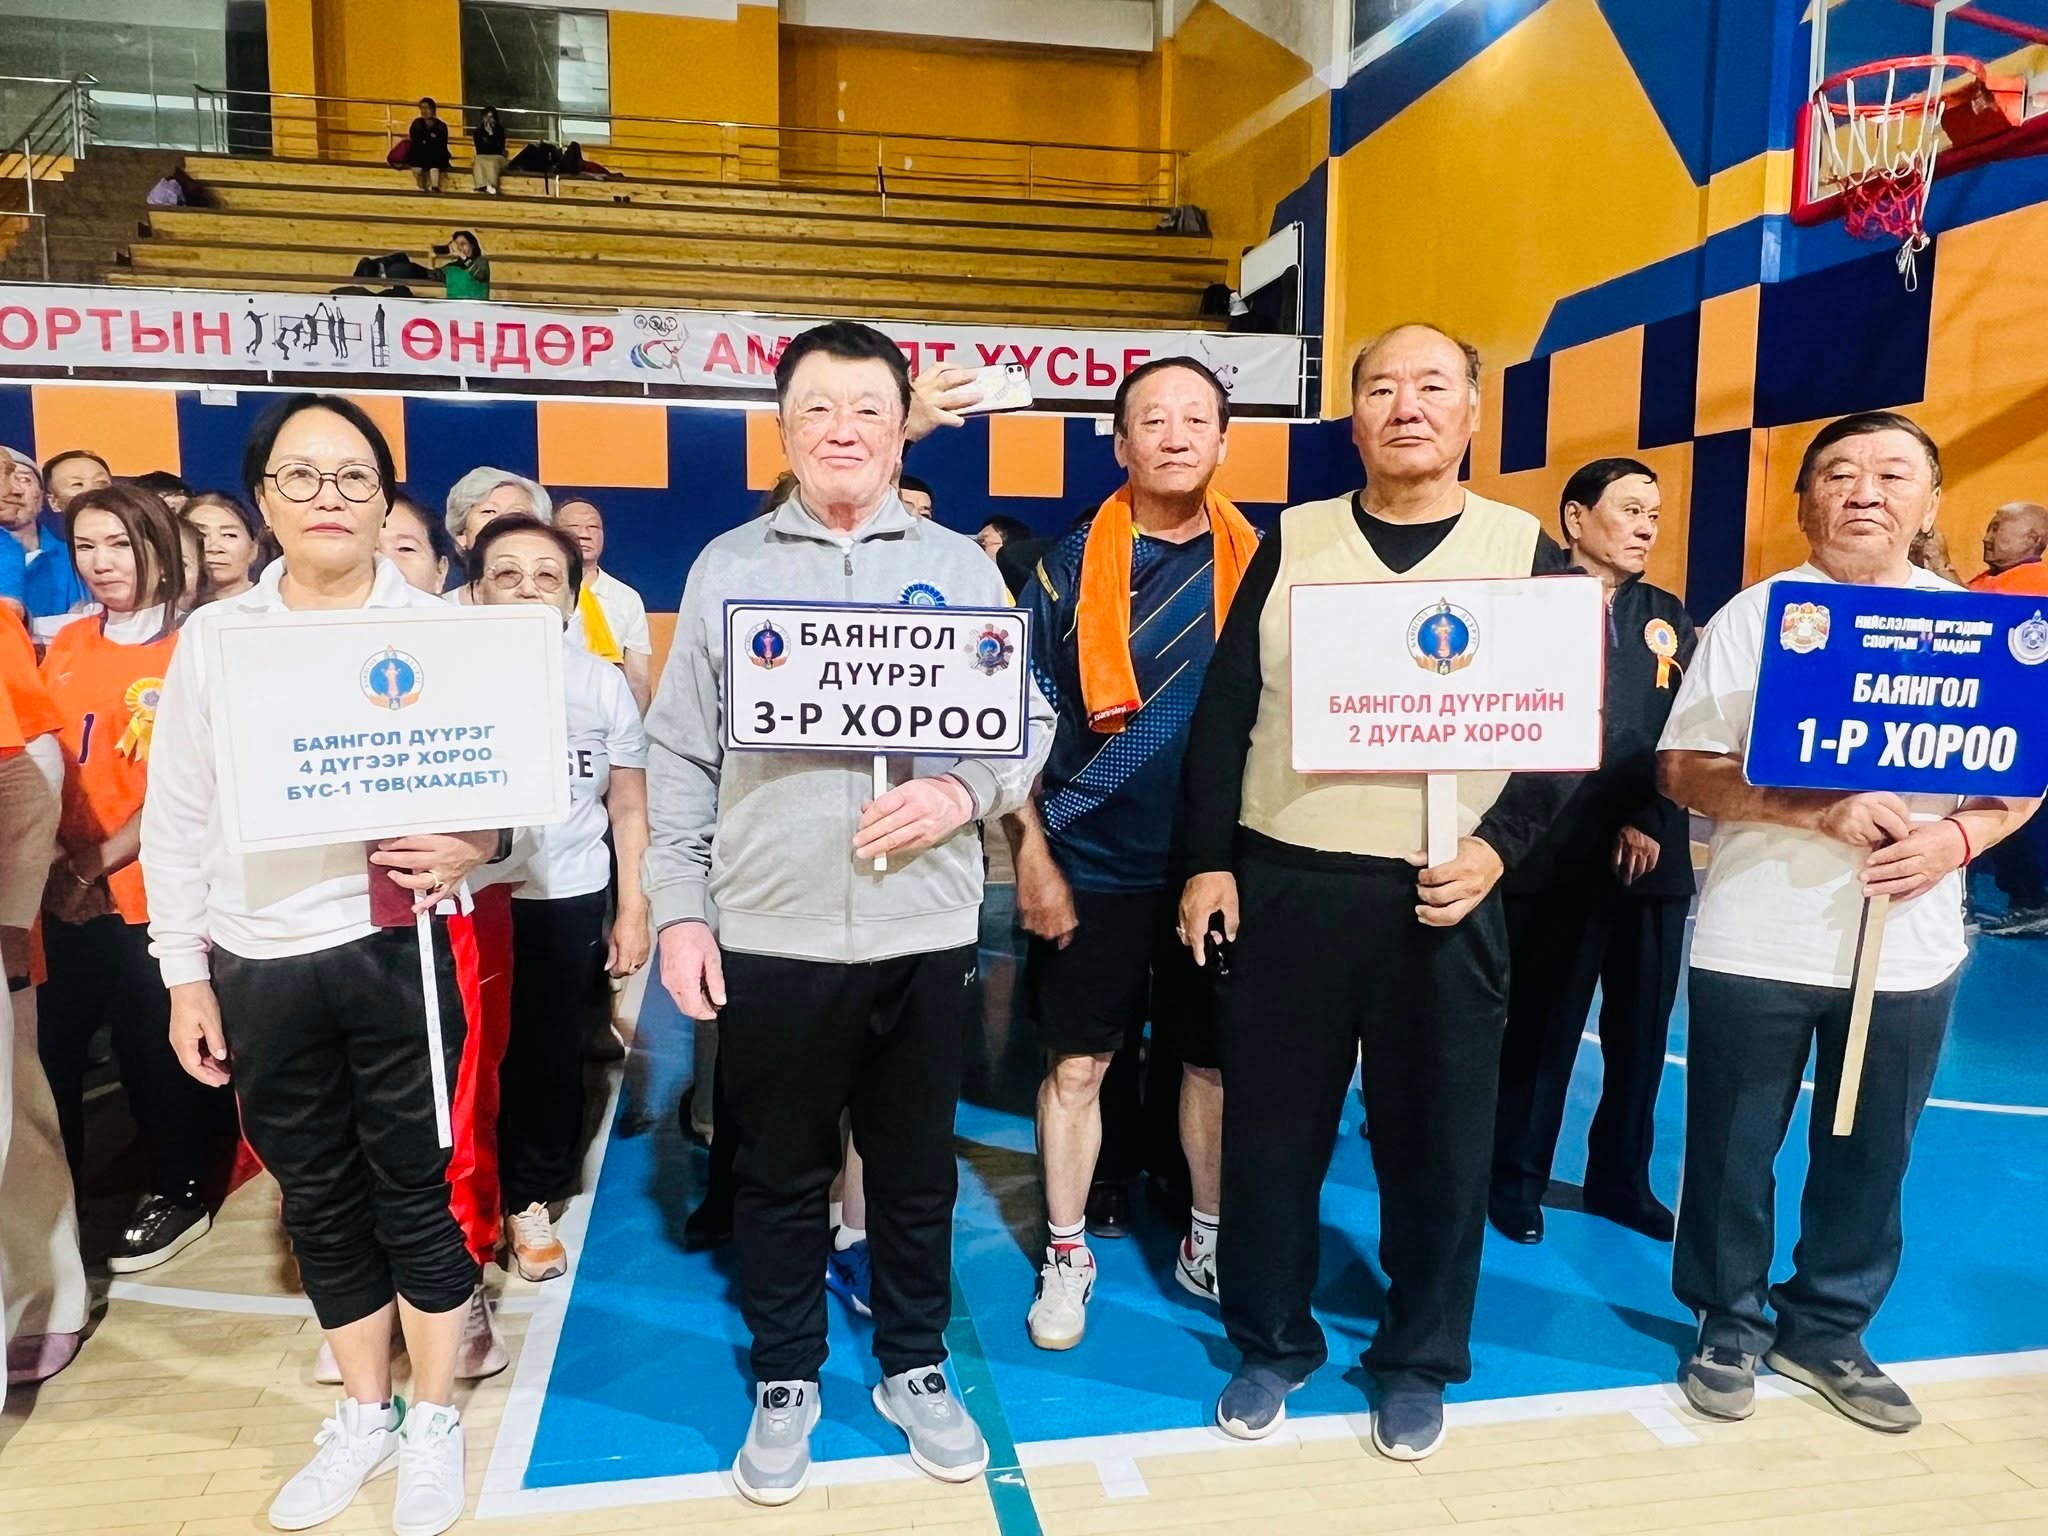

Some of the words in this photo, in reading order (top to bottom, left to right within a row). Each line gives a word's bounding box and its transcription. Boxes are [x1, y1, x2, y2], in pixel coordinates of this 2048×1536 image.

[401, 317, 614, 373] ӨНДӨР
[800, 622, 955, 650] БАЯНГОЛ
[819, 662, 945, 690] ДҮҮРЭГ
[1329, 694, 1431, 714] БАЯНГОЛ
[1439, 688, 1565, 717] ДҮҮРГИЙН
[1852, 673, 1980, 708] БАЯНГОЛ
[754, 701, 823, 735] 3-Р
[841, 703, 1007, 740] ХОРОО
[293, 731, 402, 752] БАЯНГОЛ
[409, 725, 496, 747] ДҮҮРЭГ
[1349, 725, 1361, 743] 2
[1368, 724, 1457, 747] ДУГААР
[1464, 723, 1543, 742] ХОРОО
[1797, 718, 1869, 765] 1-Р
[1877, 721, 2018, 772] ХОРОО
[299, 760, 313, 775] 4
[320, 753, 410, 775] ДҮГЭЭР
[418, 747, 493, 765] ХОРОО
[287, 782, 351, 801] БҮС-1
